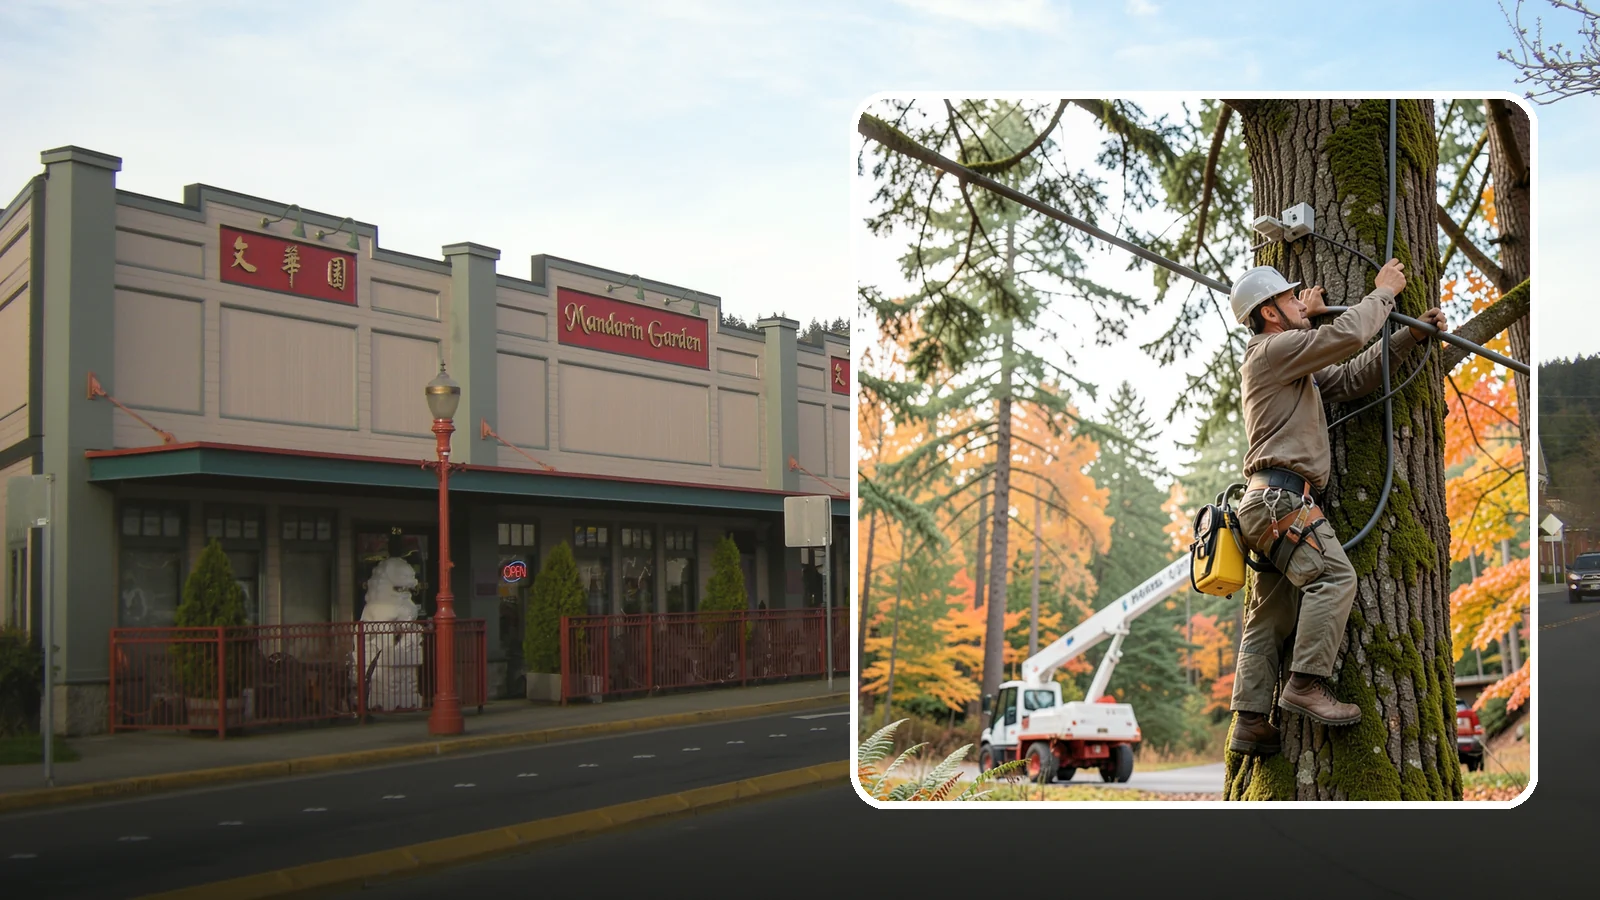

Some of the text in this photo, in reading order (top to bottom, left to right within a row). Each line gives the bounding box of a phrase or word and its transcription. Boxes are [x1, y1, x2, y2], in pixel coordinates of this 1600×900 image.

[231, 236, 346, 290] 文華園
[564, 302, 702, 352] Mandarin Garden
[503, 565, 527, 578] OPEN
